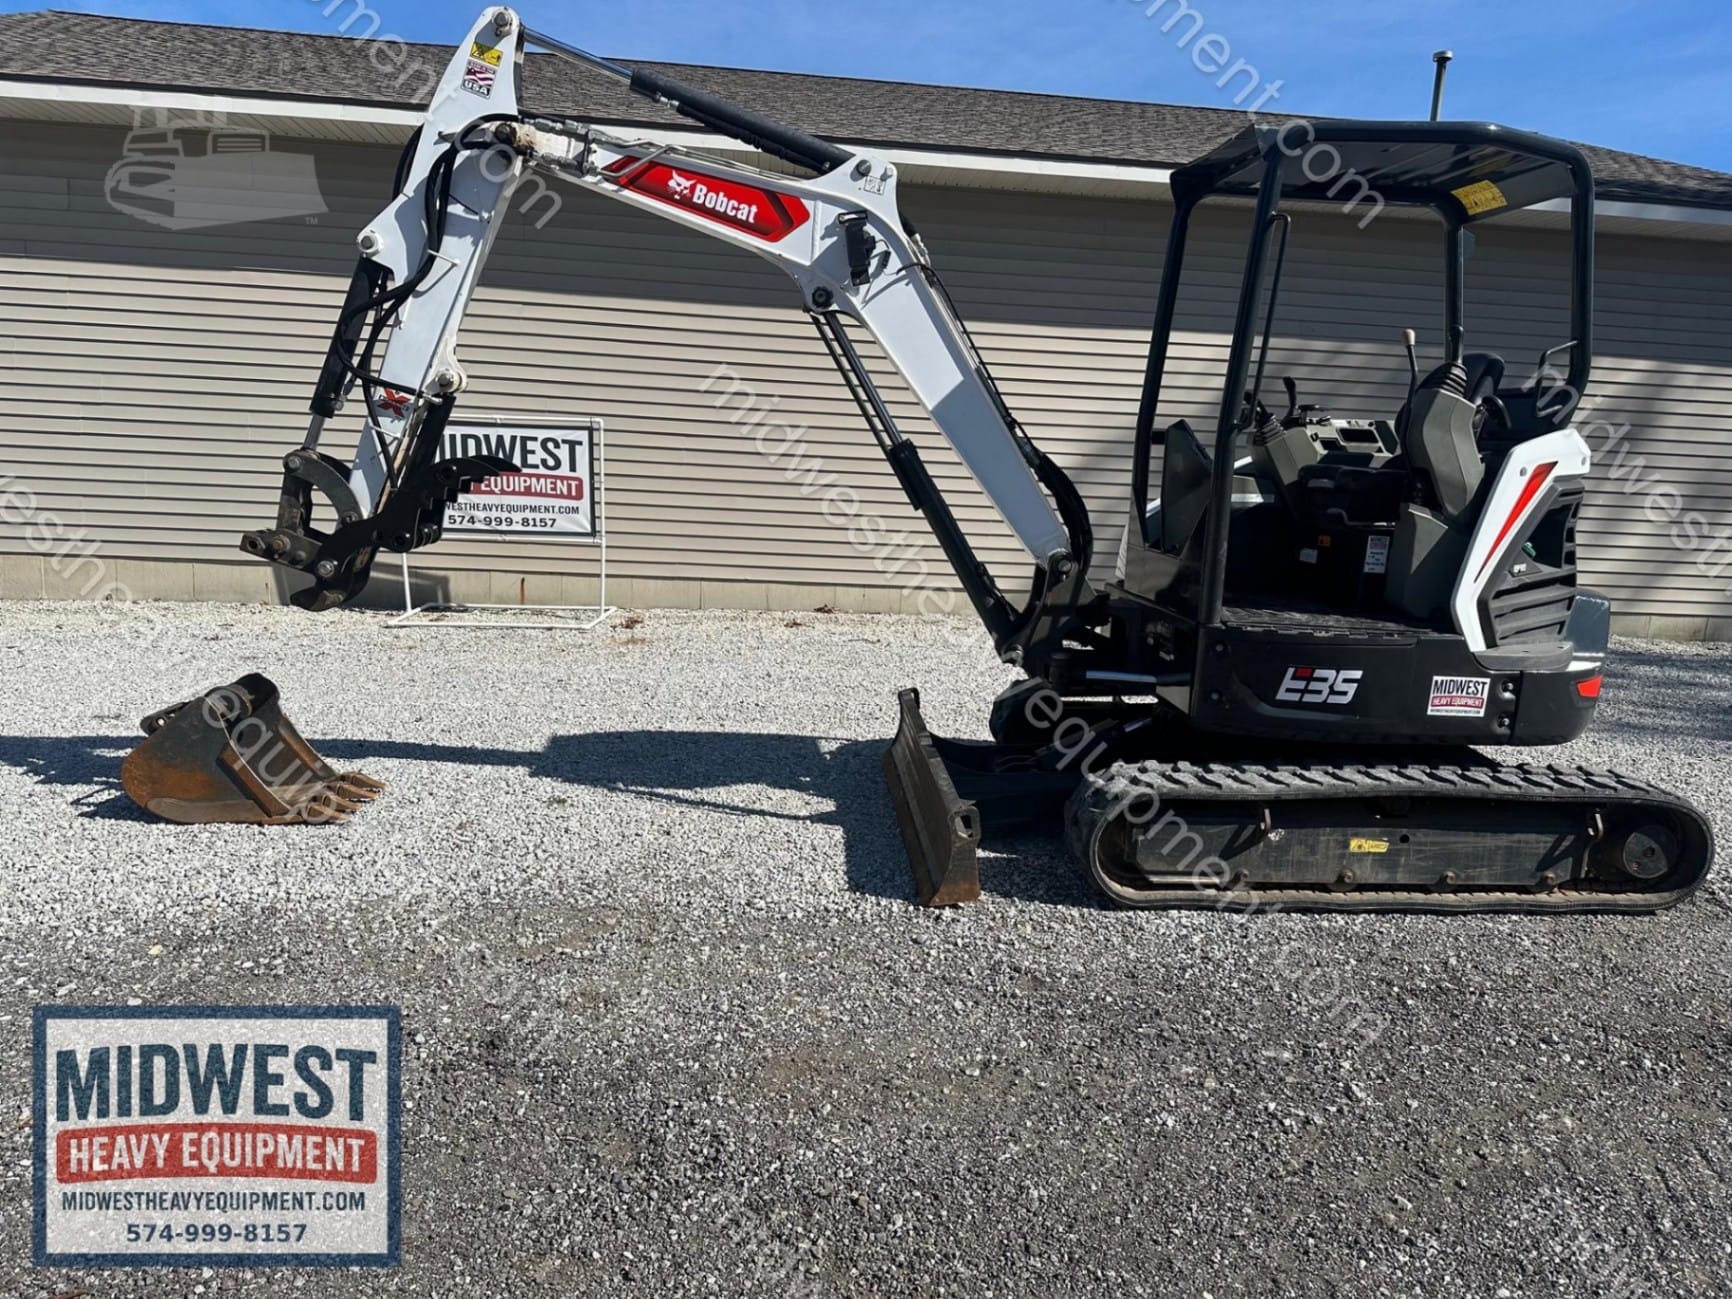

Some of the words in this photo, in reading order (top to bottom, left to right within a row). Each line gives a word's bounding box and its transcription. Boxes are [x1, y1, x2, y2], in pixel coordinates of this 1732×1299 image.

[464, 80, 489, 95] USA
[692, 184, 758, 224] Bobcat
[481, 475, 579, 496] EQUIPMENT
[448, 515, 557, 528] 574-999-8157
[1275, 667, 1363, 704] E35
[1432, 679, 1488, 697] MIDWEST
